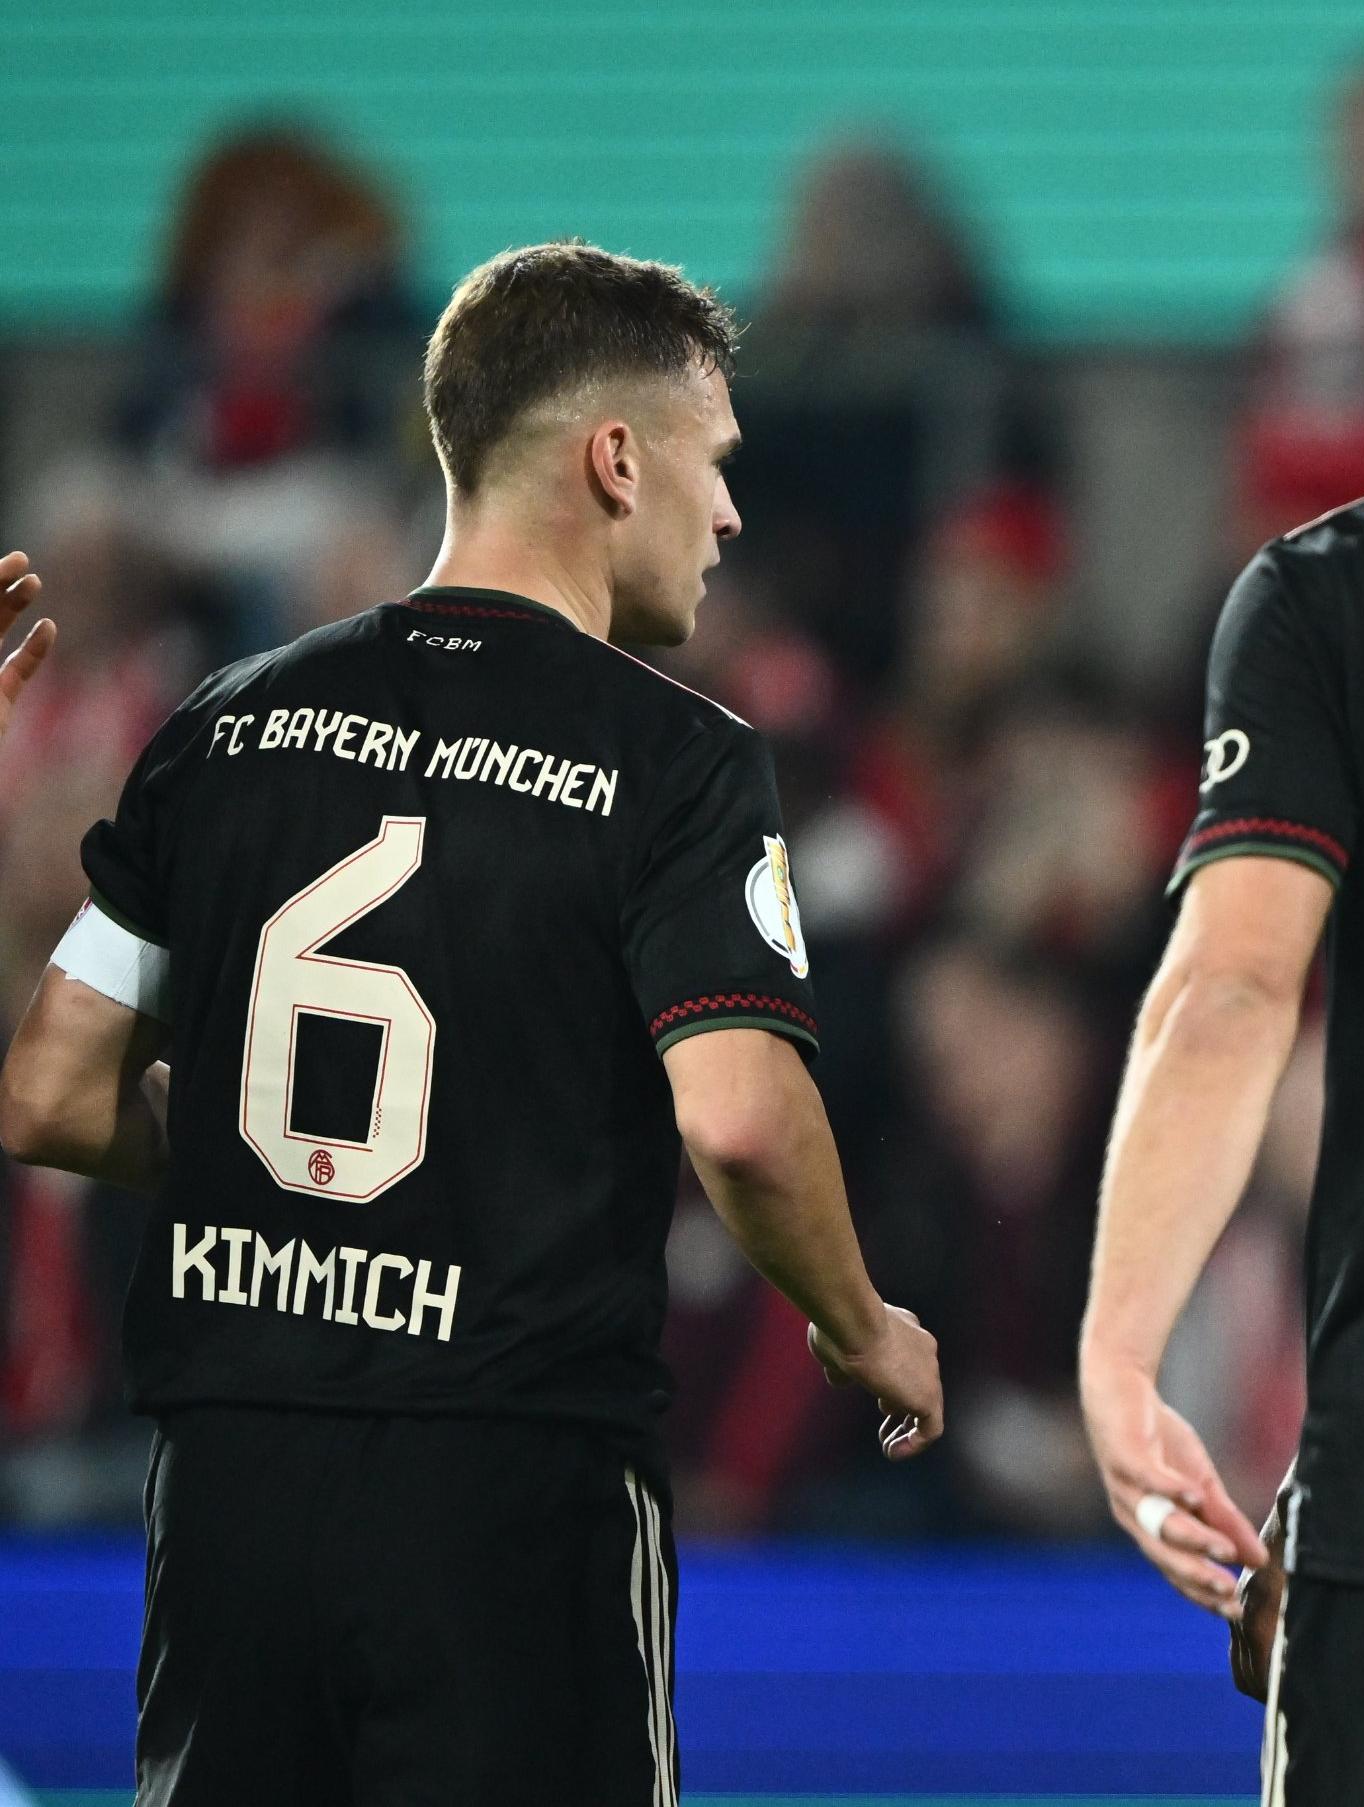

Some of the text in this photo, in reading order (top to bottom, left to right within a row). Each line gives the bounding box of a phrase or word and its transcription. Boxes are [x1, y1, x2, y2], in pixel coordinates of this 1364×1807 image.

[407, 630, 482, 652] FCBM
[207, 707, 619, 817] FC BAYERN MÜNCHEN
[239, 815, 437, 1204] 6
[172, 1223, 462, 1342] KIMMICH
